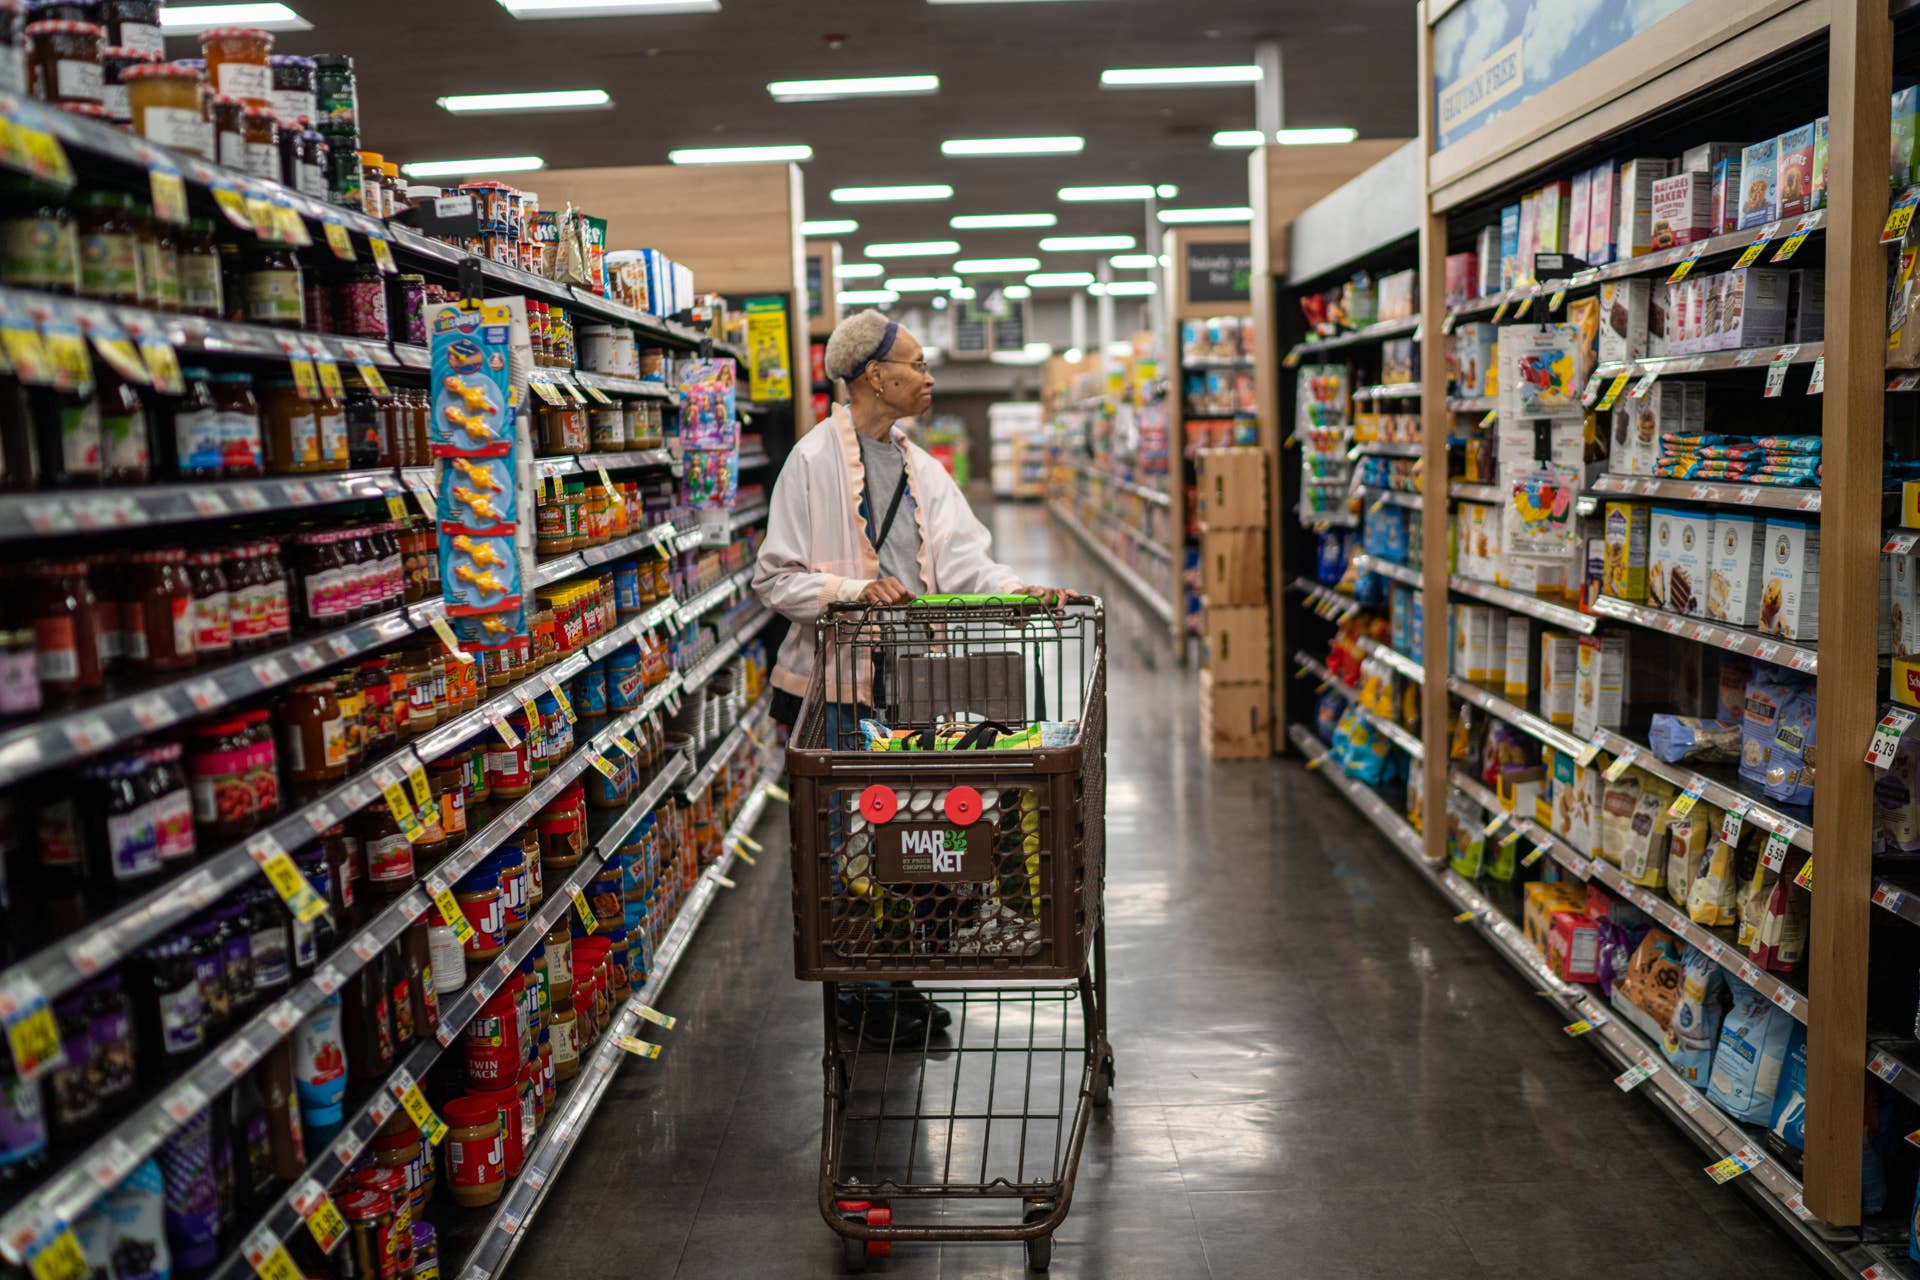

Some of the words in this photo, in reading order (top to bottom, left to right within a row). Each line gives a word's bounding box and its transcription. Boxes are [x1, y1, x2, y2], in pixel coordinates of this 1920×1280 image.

[1442, 76, 1484, 121] GLUTEN
[1486, 51, 1517, 95] FREE
[1653, 188, 1689, 206] BAKERY
[1889, 212, 1911, 231] 3.99
[1873, 739, 1896, 757] 6.79
[1723, 821, 1738, 837] 8.79
[1767, 844, 1785, 862] 5.59
